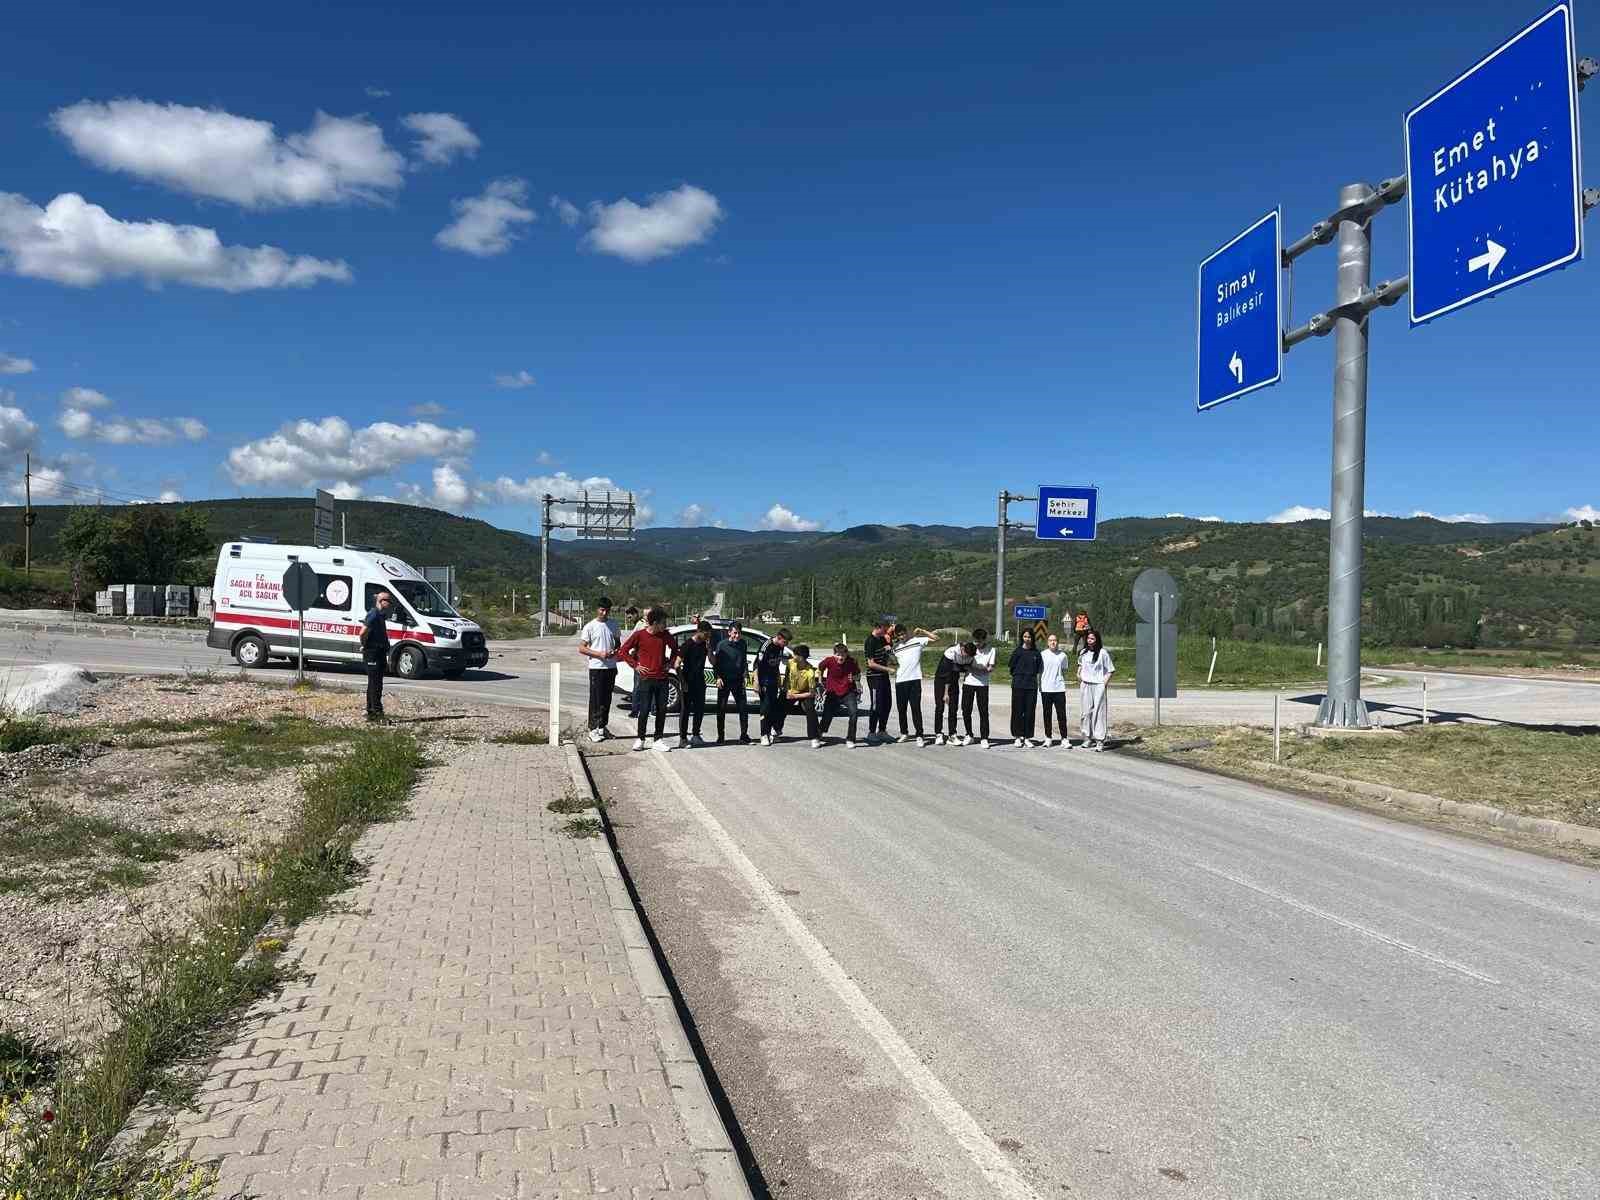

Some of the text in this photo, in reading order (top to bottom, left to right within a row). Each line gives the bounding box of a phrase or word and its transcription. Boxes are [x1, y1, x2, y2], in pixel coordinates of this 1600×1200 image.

[1433, 117, 1497, 177] Emet
[1435, 138, 1540, 213] Kütahya
[1217, 268, 1256, 303] Simav
[1049, 508, 1085, 516] Merkezi
[304, 622, 348, 634] MBULANS
